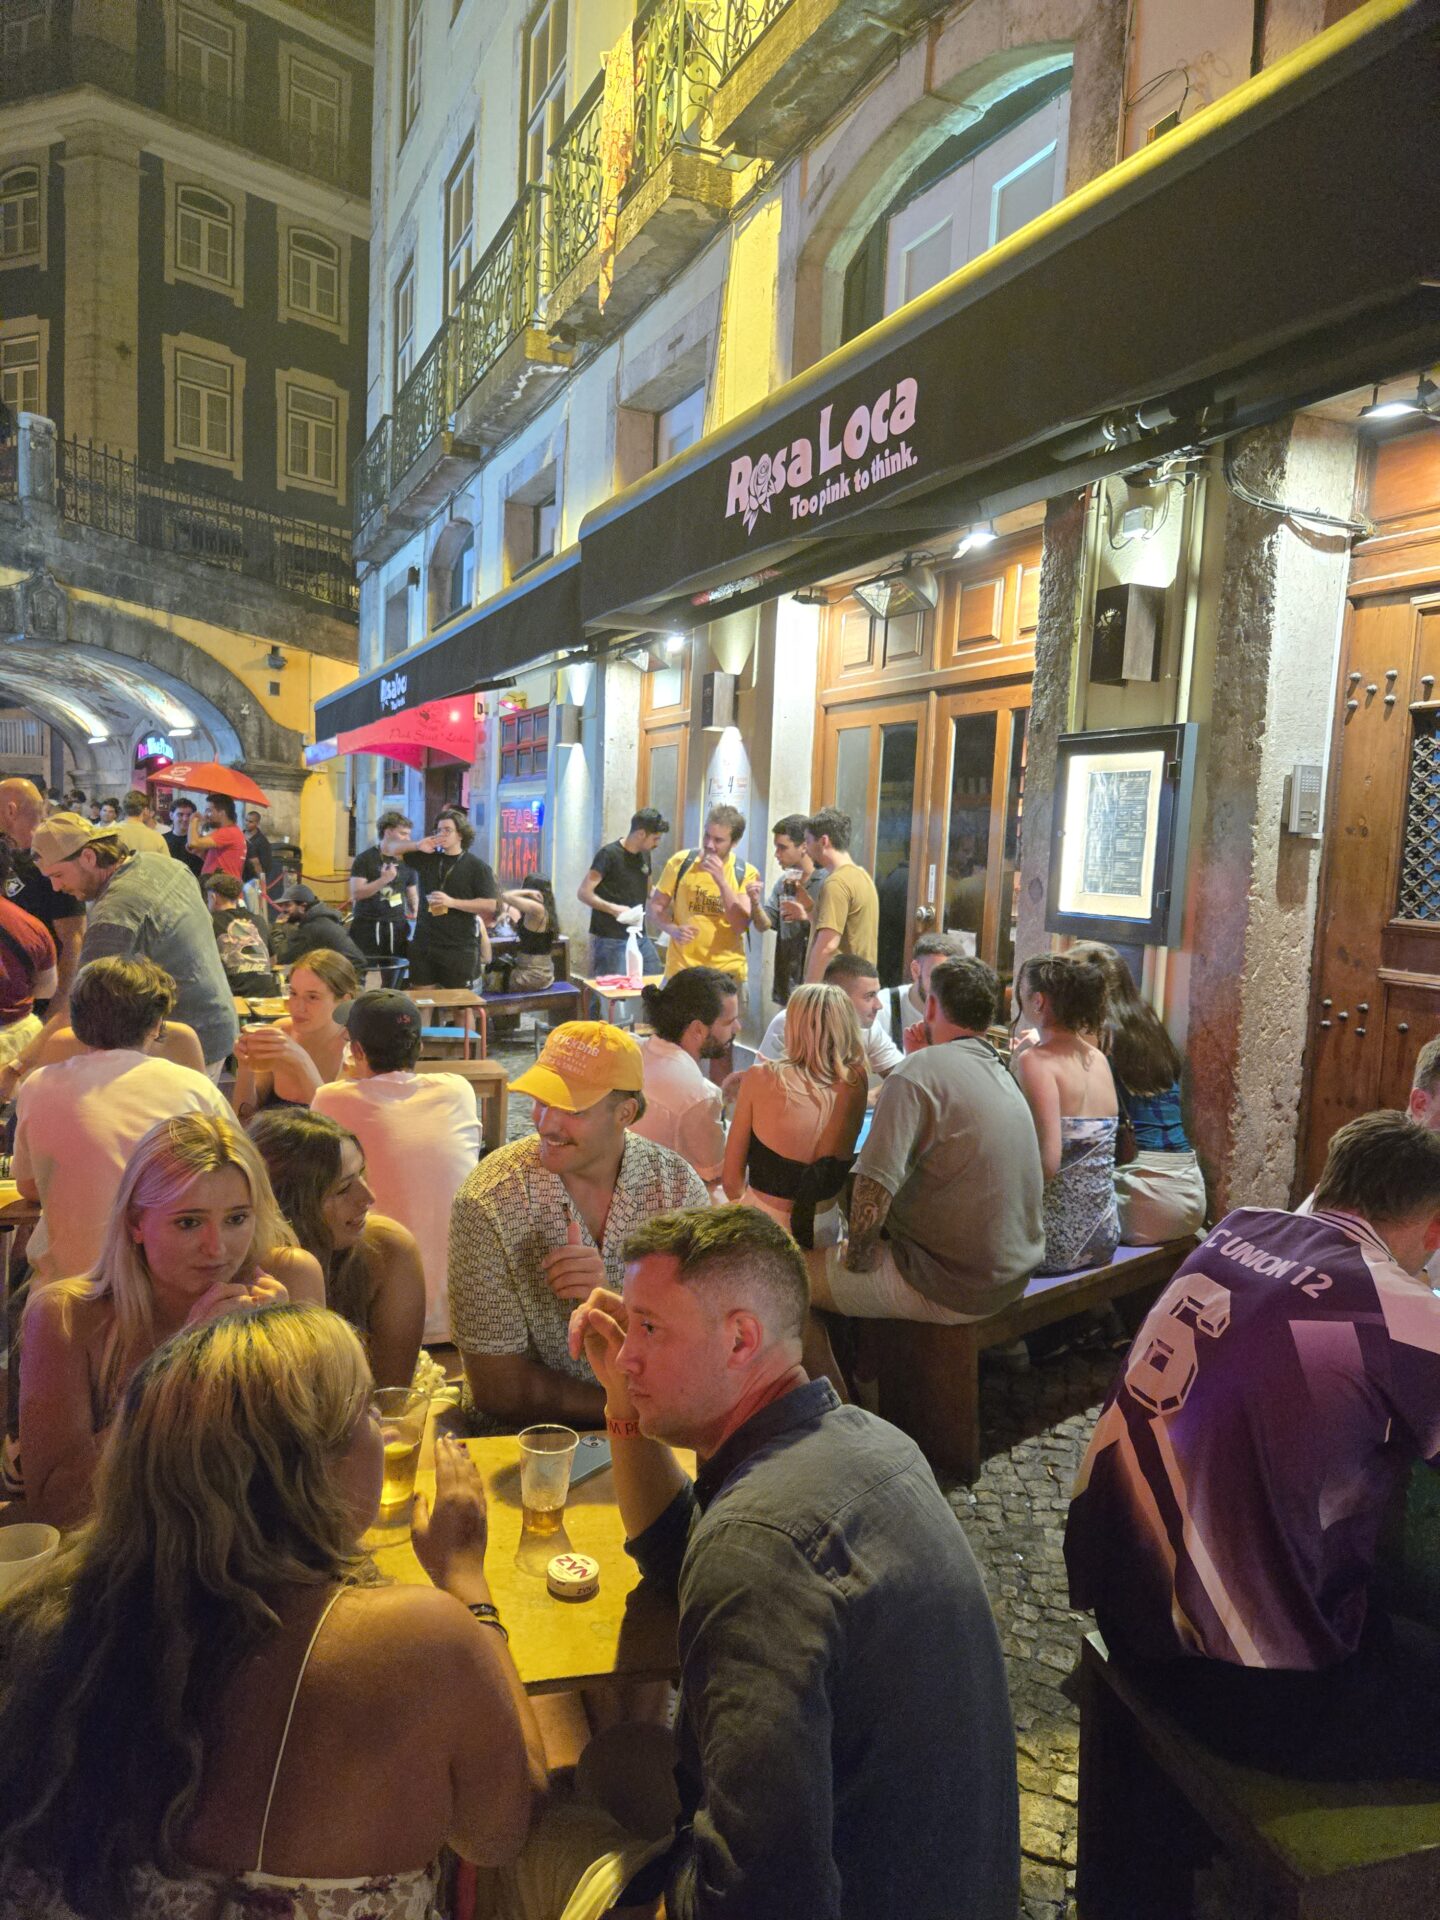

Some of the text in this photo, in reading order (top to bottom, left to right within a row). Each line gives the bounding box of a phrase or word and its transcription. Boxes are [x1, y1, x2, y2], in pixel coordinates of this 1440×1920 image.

[725, 377, 918, 519] Rosa Loca
[789, 440, 919, 520] Too pink to think.
[1219, 1236, 1299, 1279] UNION
[1290, 1265, 1334, 1299] 12
[555, 1555, 593, 1579] ZYN
